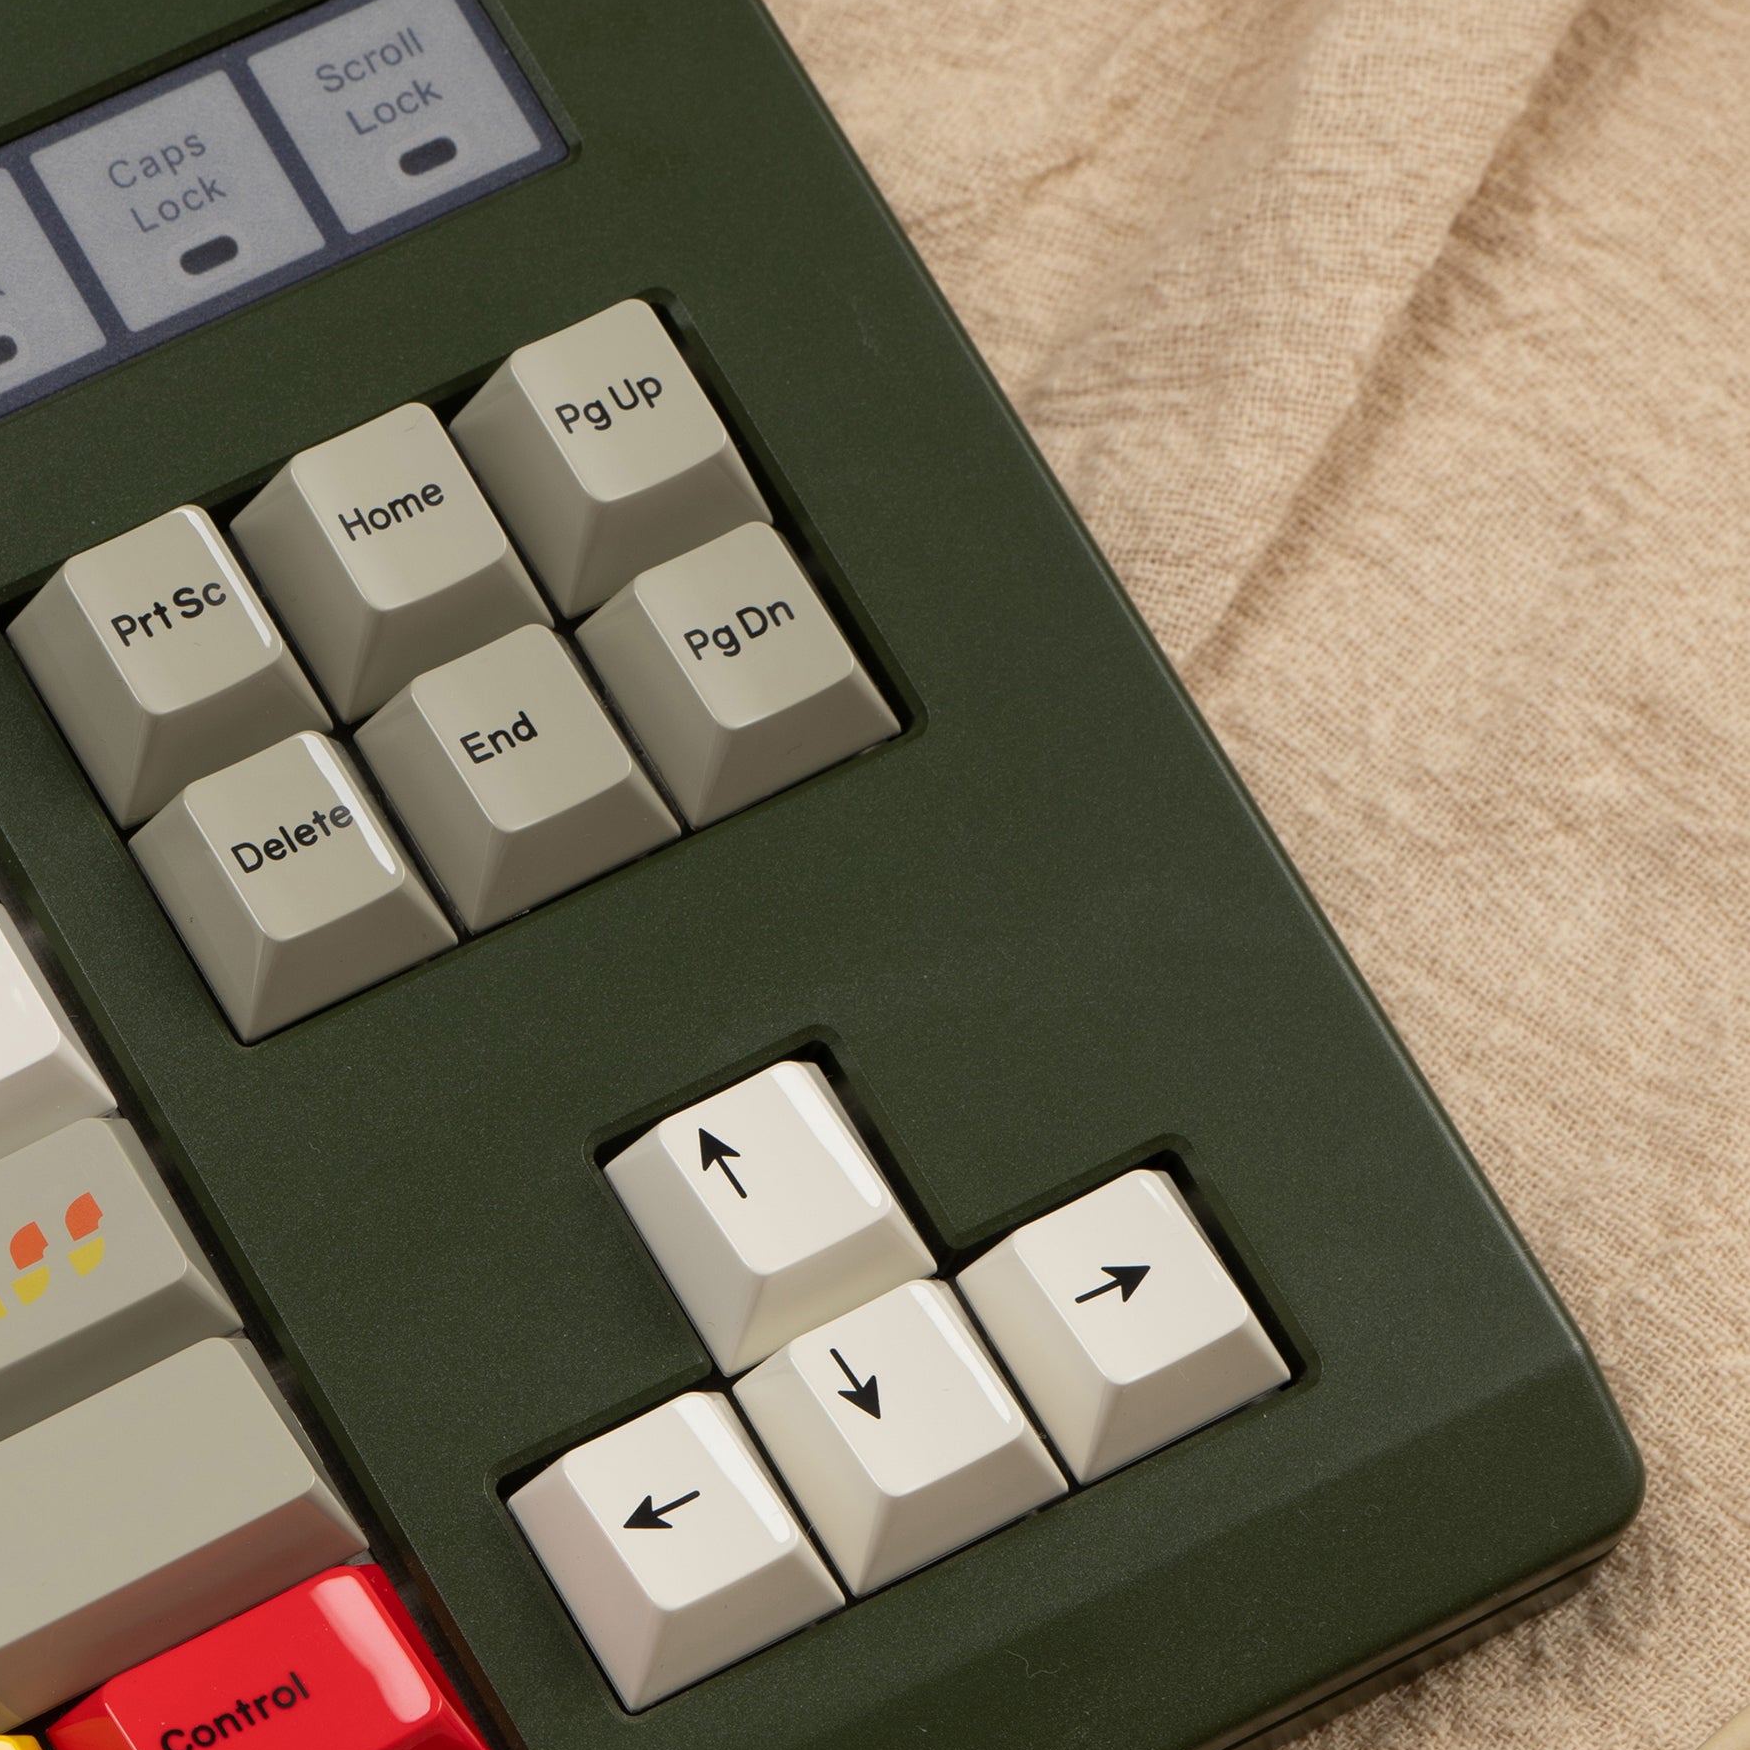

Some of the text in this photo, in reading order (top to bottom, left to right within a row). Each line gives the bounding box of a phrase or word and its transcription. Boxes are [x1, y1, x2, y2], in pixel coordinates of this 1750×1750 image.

[316, 27, 427, 95] Scroll
[345, 78, 444, 137] Lock
[107, 130, 209, 193] Caps
[130, 175, 229, 235] Lock
[337, 483, 445, 542] Home
[459, 710, 539, 764] End
[230, 805, 354, 874] Delete
